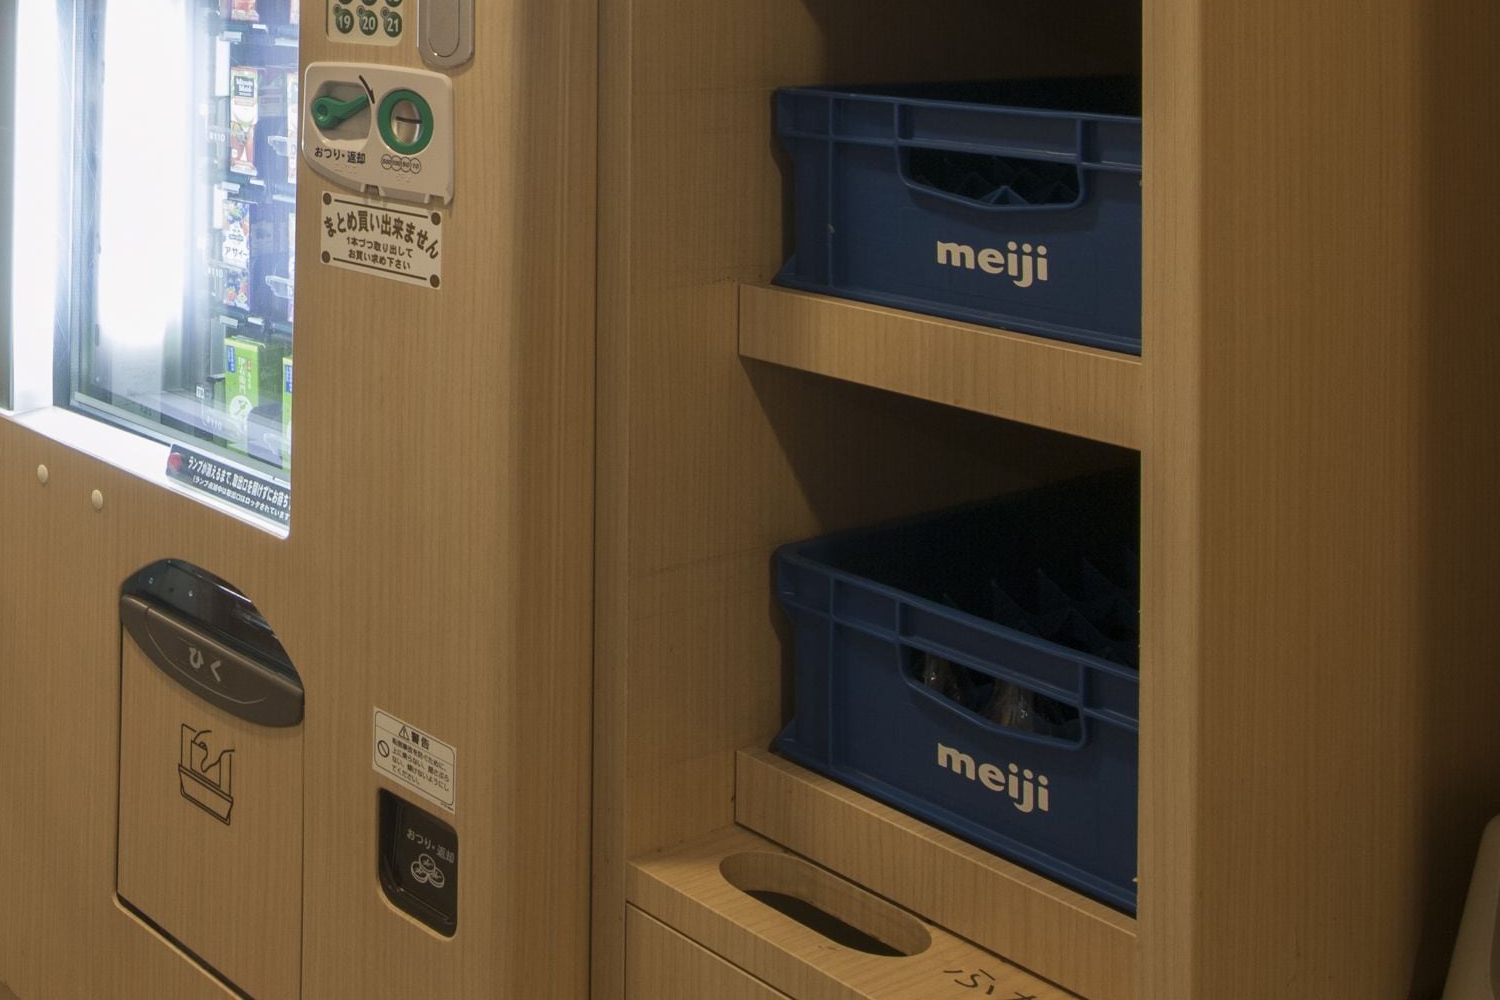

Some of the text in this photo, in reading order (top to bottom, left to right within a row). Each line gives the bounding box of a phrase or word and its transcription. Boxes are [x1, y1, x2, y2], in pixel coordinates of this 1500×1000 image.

[338, 15, 399, 32] 19 20 21
[314, 147, 366, 165] おつり・返却
[324, 210, 439, 260] まとめ買い出来ません
[348, 249, 411, 271] お買い求め下さい
[937, 240, 1048, 287] meiji
[188, 455, 291, 511] ランプが消えるまで、取出口を開けずにお待ち
[189, 647, 221, 682] ひく
[937, 742, 1049, 813] meiji
